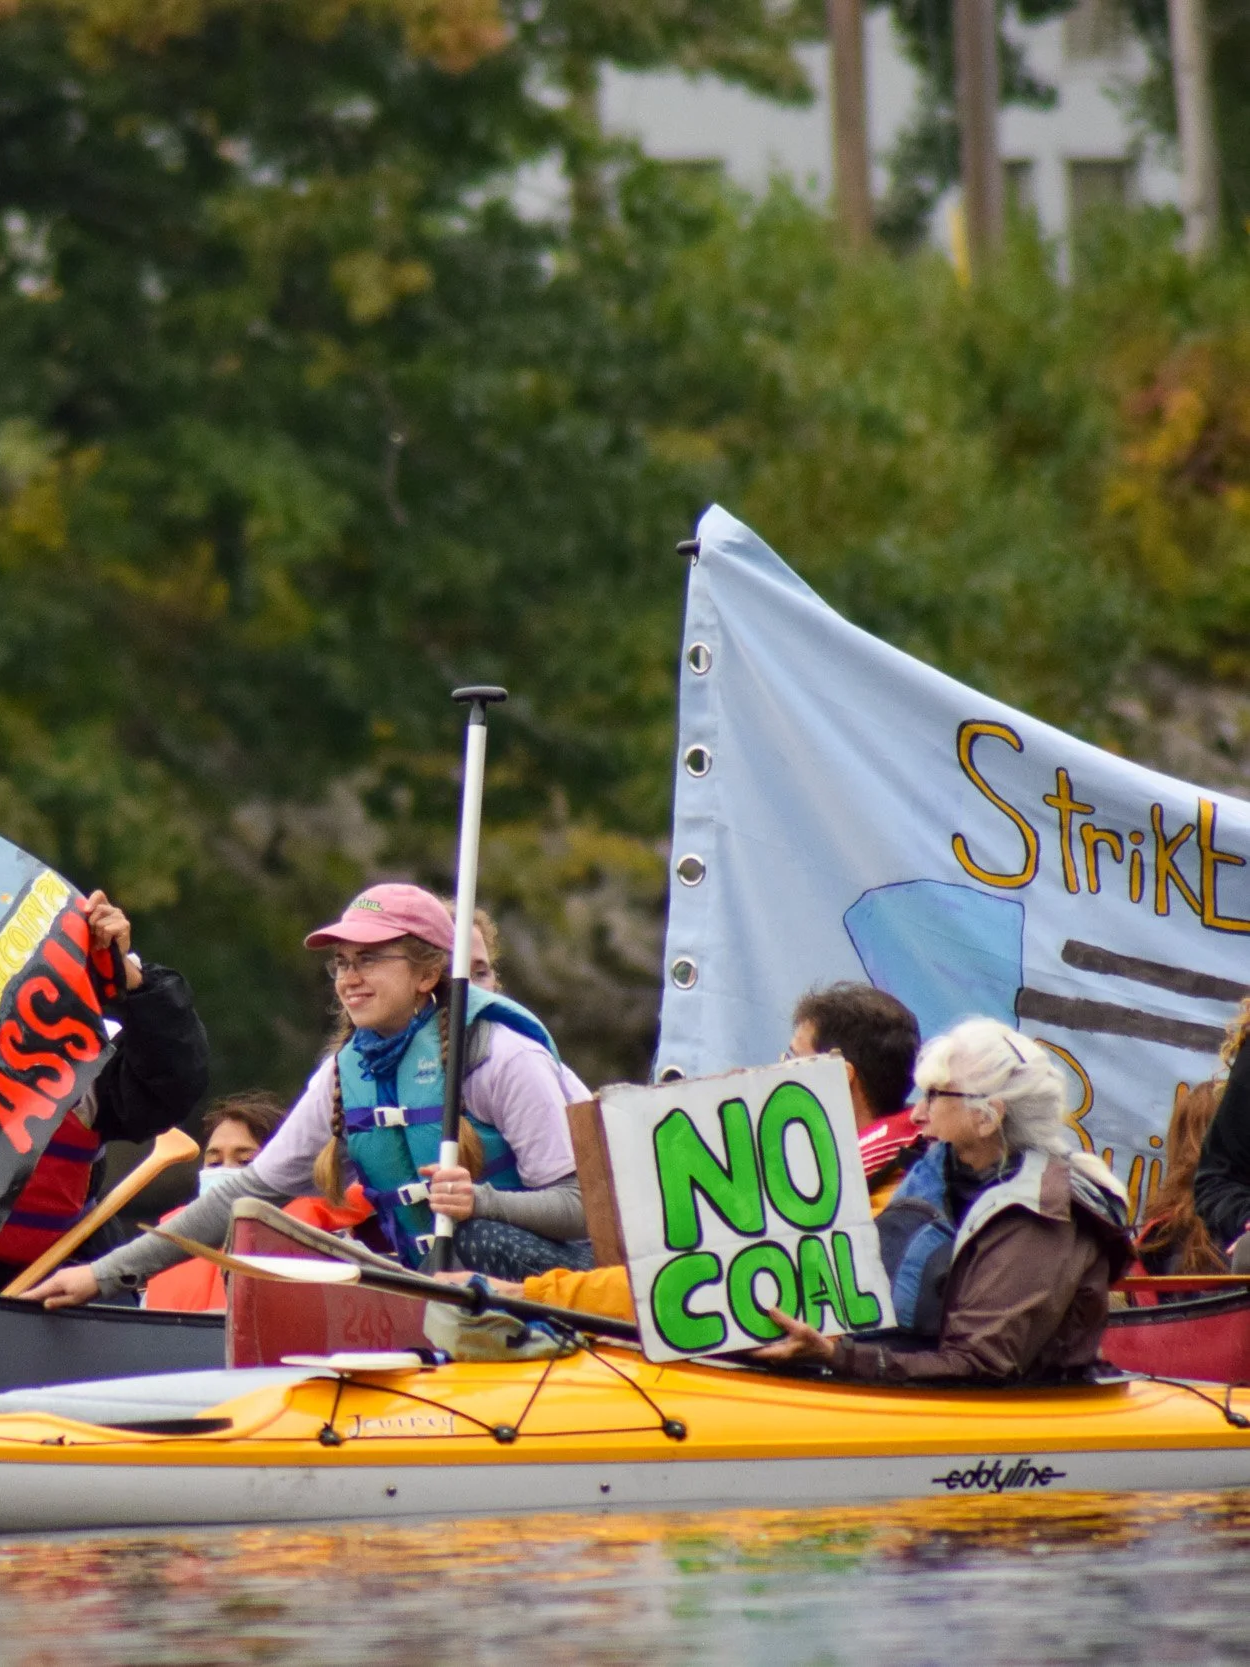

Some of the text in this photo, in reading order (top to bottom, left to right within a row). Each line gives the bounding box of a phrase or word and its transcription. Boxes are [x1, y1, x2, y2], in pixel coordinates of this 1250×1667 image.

[653, 1081, 842, 1251] NO
[650, 1231, 883, 1354] COAL
[940, 1458, 1059, 1494] eddyline
